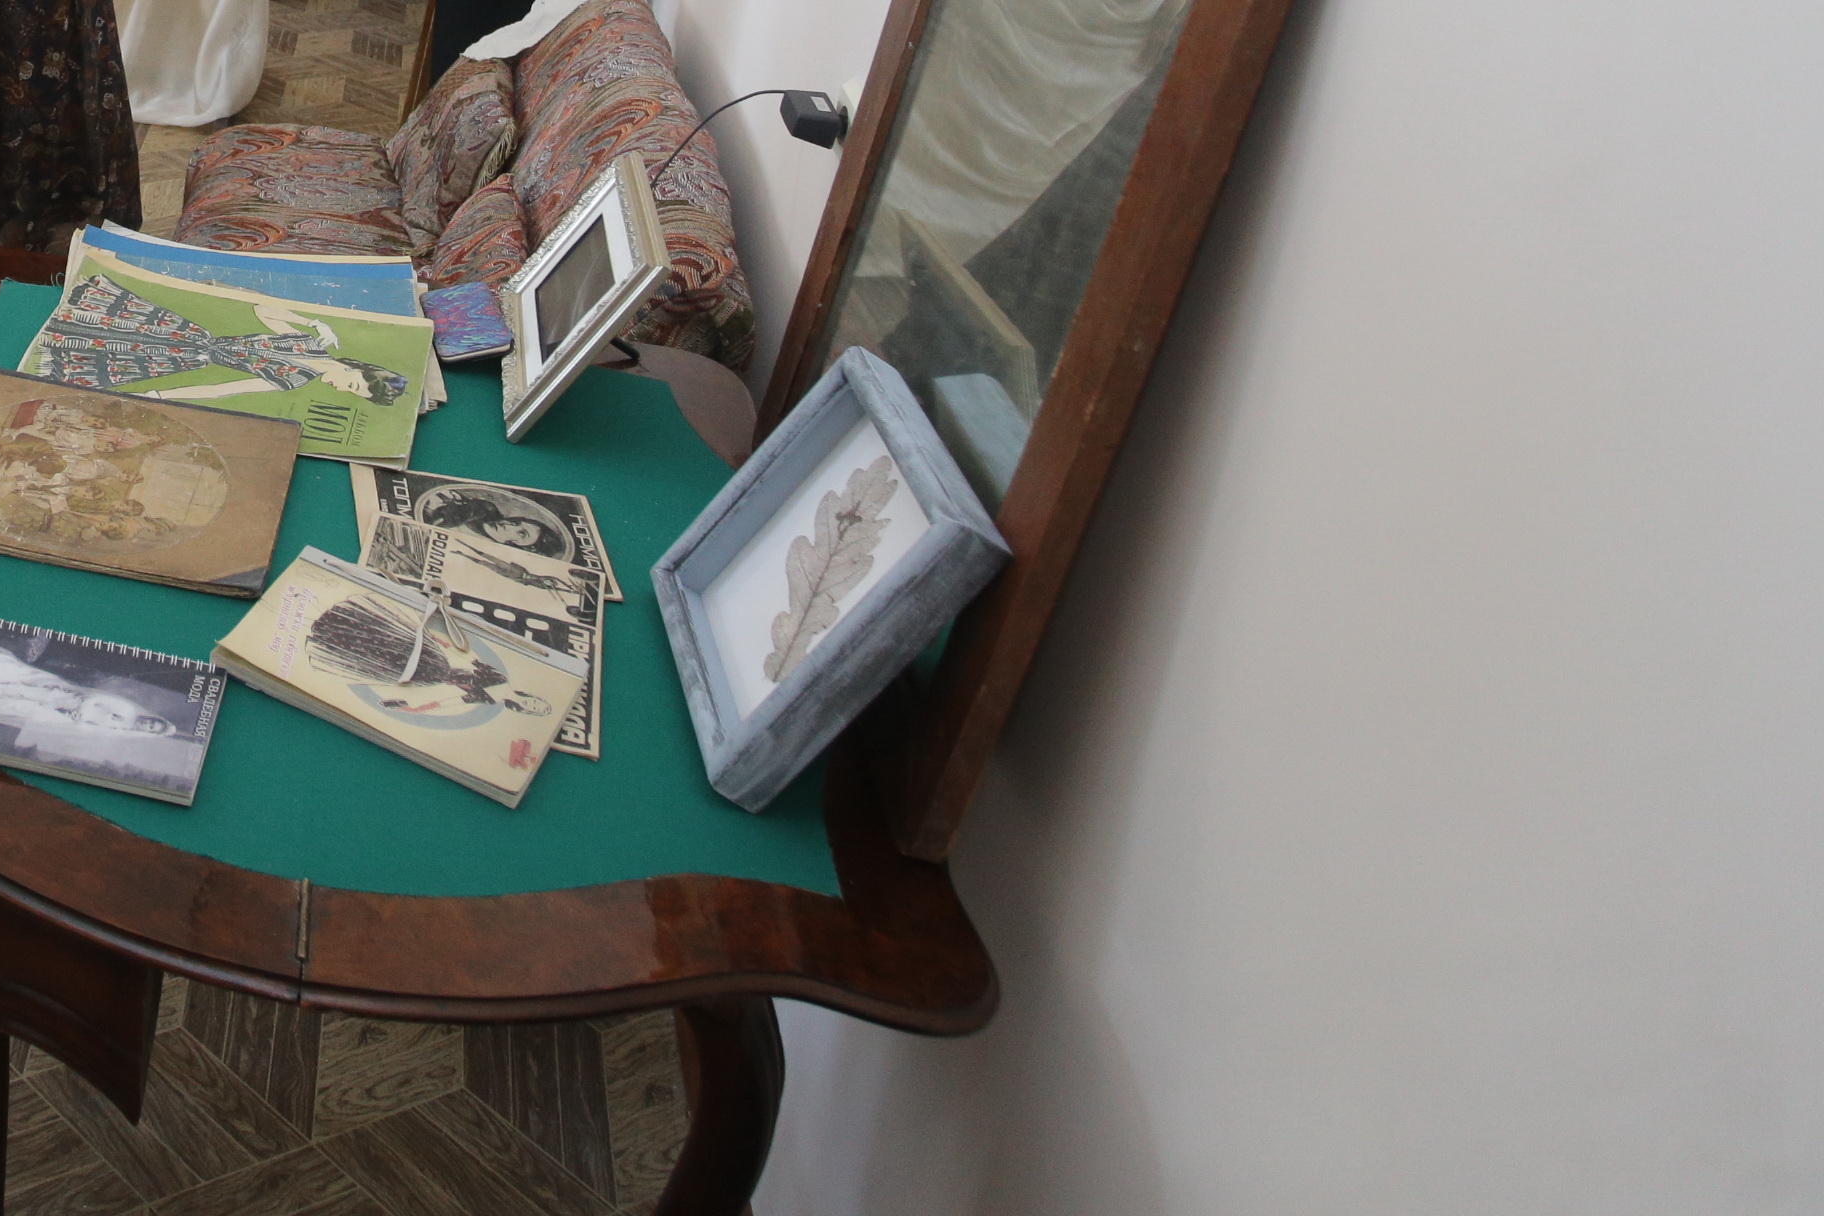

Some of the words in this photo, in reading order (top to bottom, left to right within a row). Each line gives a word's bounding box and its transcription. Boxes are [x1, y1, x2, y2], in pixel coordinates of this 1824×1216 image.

[568, 513, 603, 571] НОРМА
[187, 674, 206, 704] МОДА
[192, 677, 221, 738] СВАДЕБНАЯ
